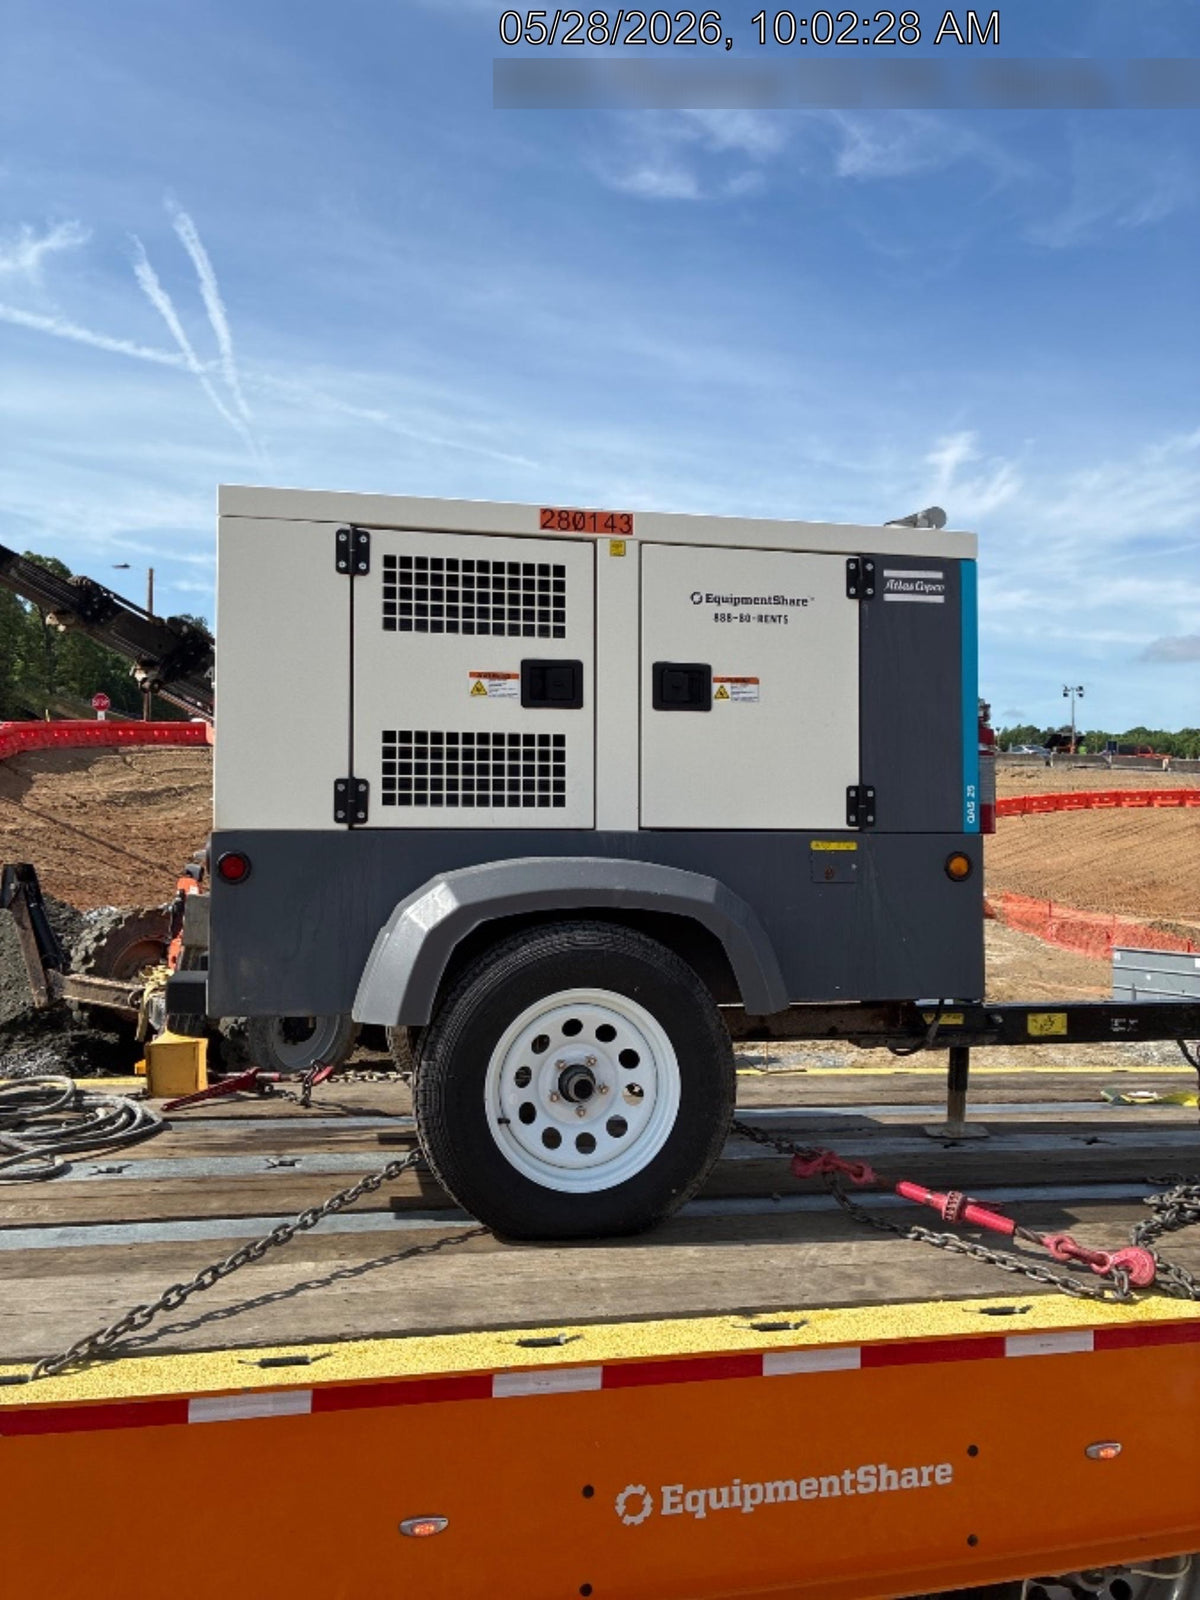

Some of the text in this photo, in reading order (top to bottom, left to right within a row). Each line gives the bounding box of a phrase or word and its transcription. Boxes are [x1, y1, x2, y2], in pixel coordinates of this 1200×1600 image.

[541, 508, 632, 534] 280143
[884, 579, 945, 594] Atlas Copco
[660, 1462, 954, 1519] EquipmentShare
